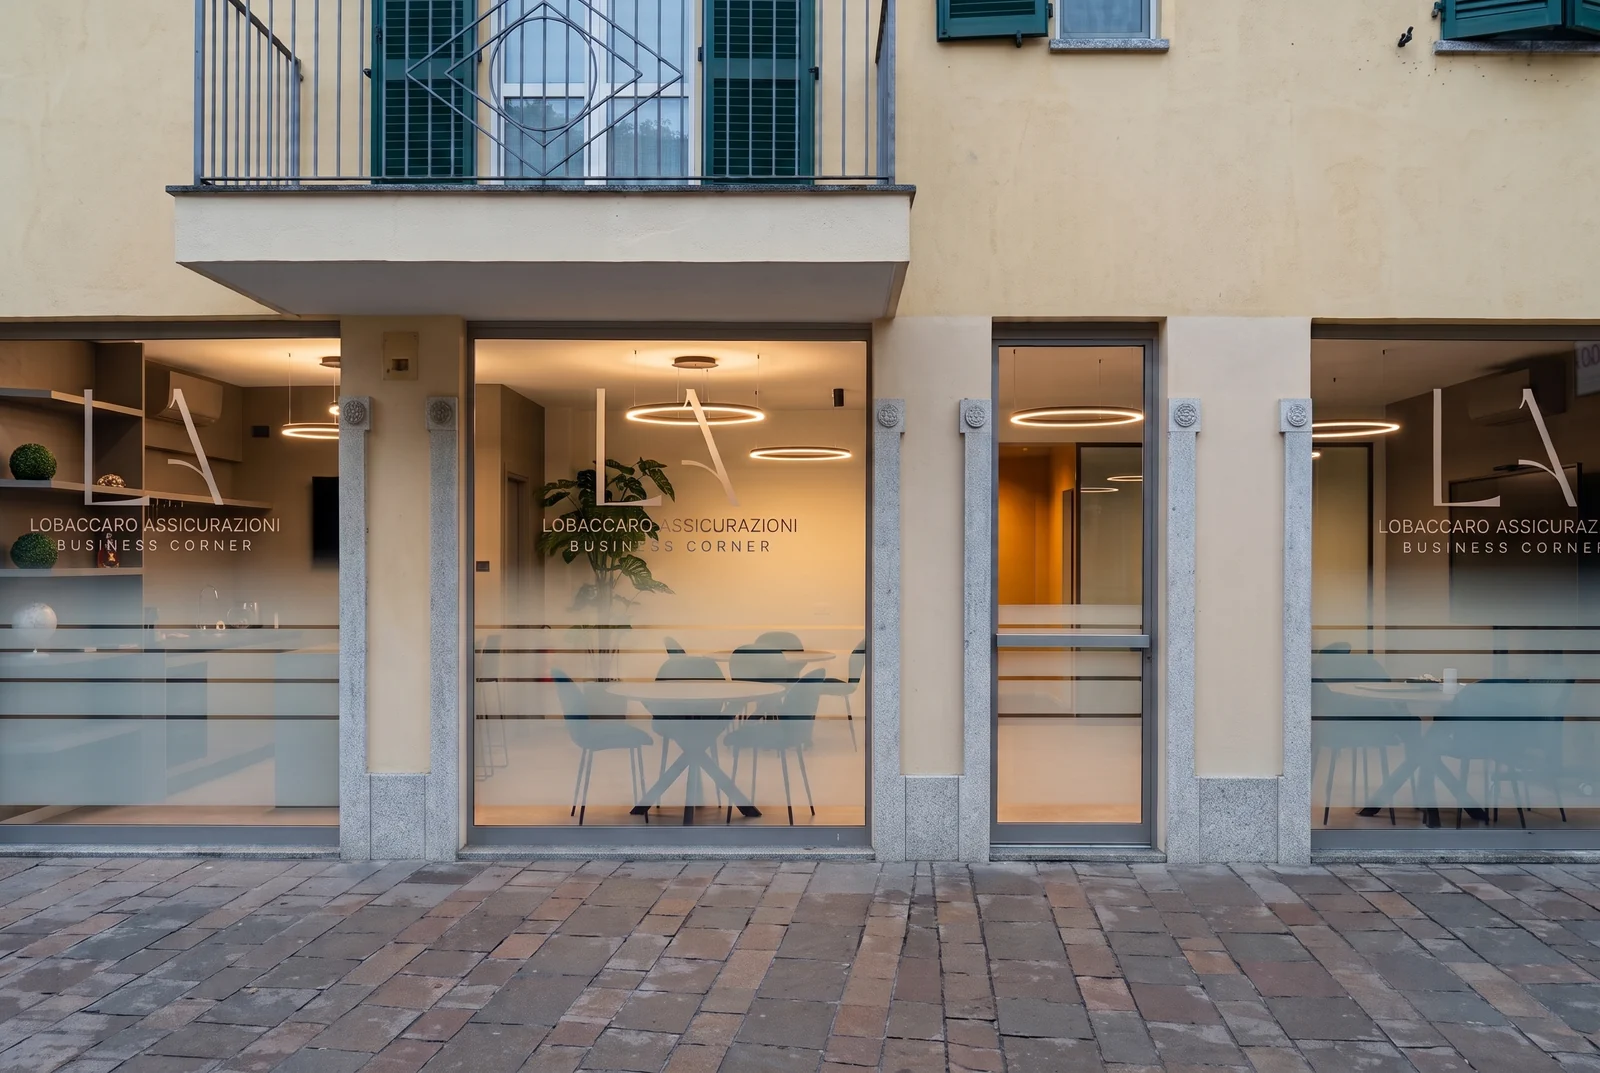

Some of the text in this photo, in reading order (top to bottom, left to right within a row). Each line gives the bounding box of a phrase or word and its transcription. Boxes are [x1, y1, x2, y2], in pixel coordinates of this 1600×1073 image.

[30, 517, 281, 533] LOBACCARO ASSICURAZIONI
[542, 518, 797, 533] LOBACCARO ASSICURAZIONI
[1378, 519, 1490, 534] LOBACCARO
[57, 539, 252, 551] BUSINESS CORNER
[686, 540, 771, 552] CORNER
[1403, 541, 1600, 554] BUSINESS CORNE
